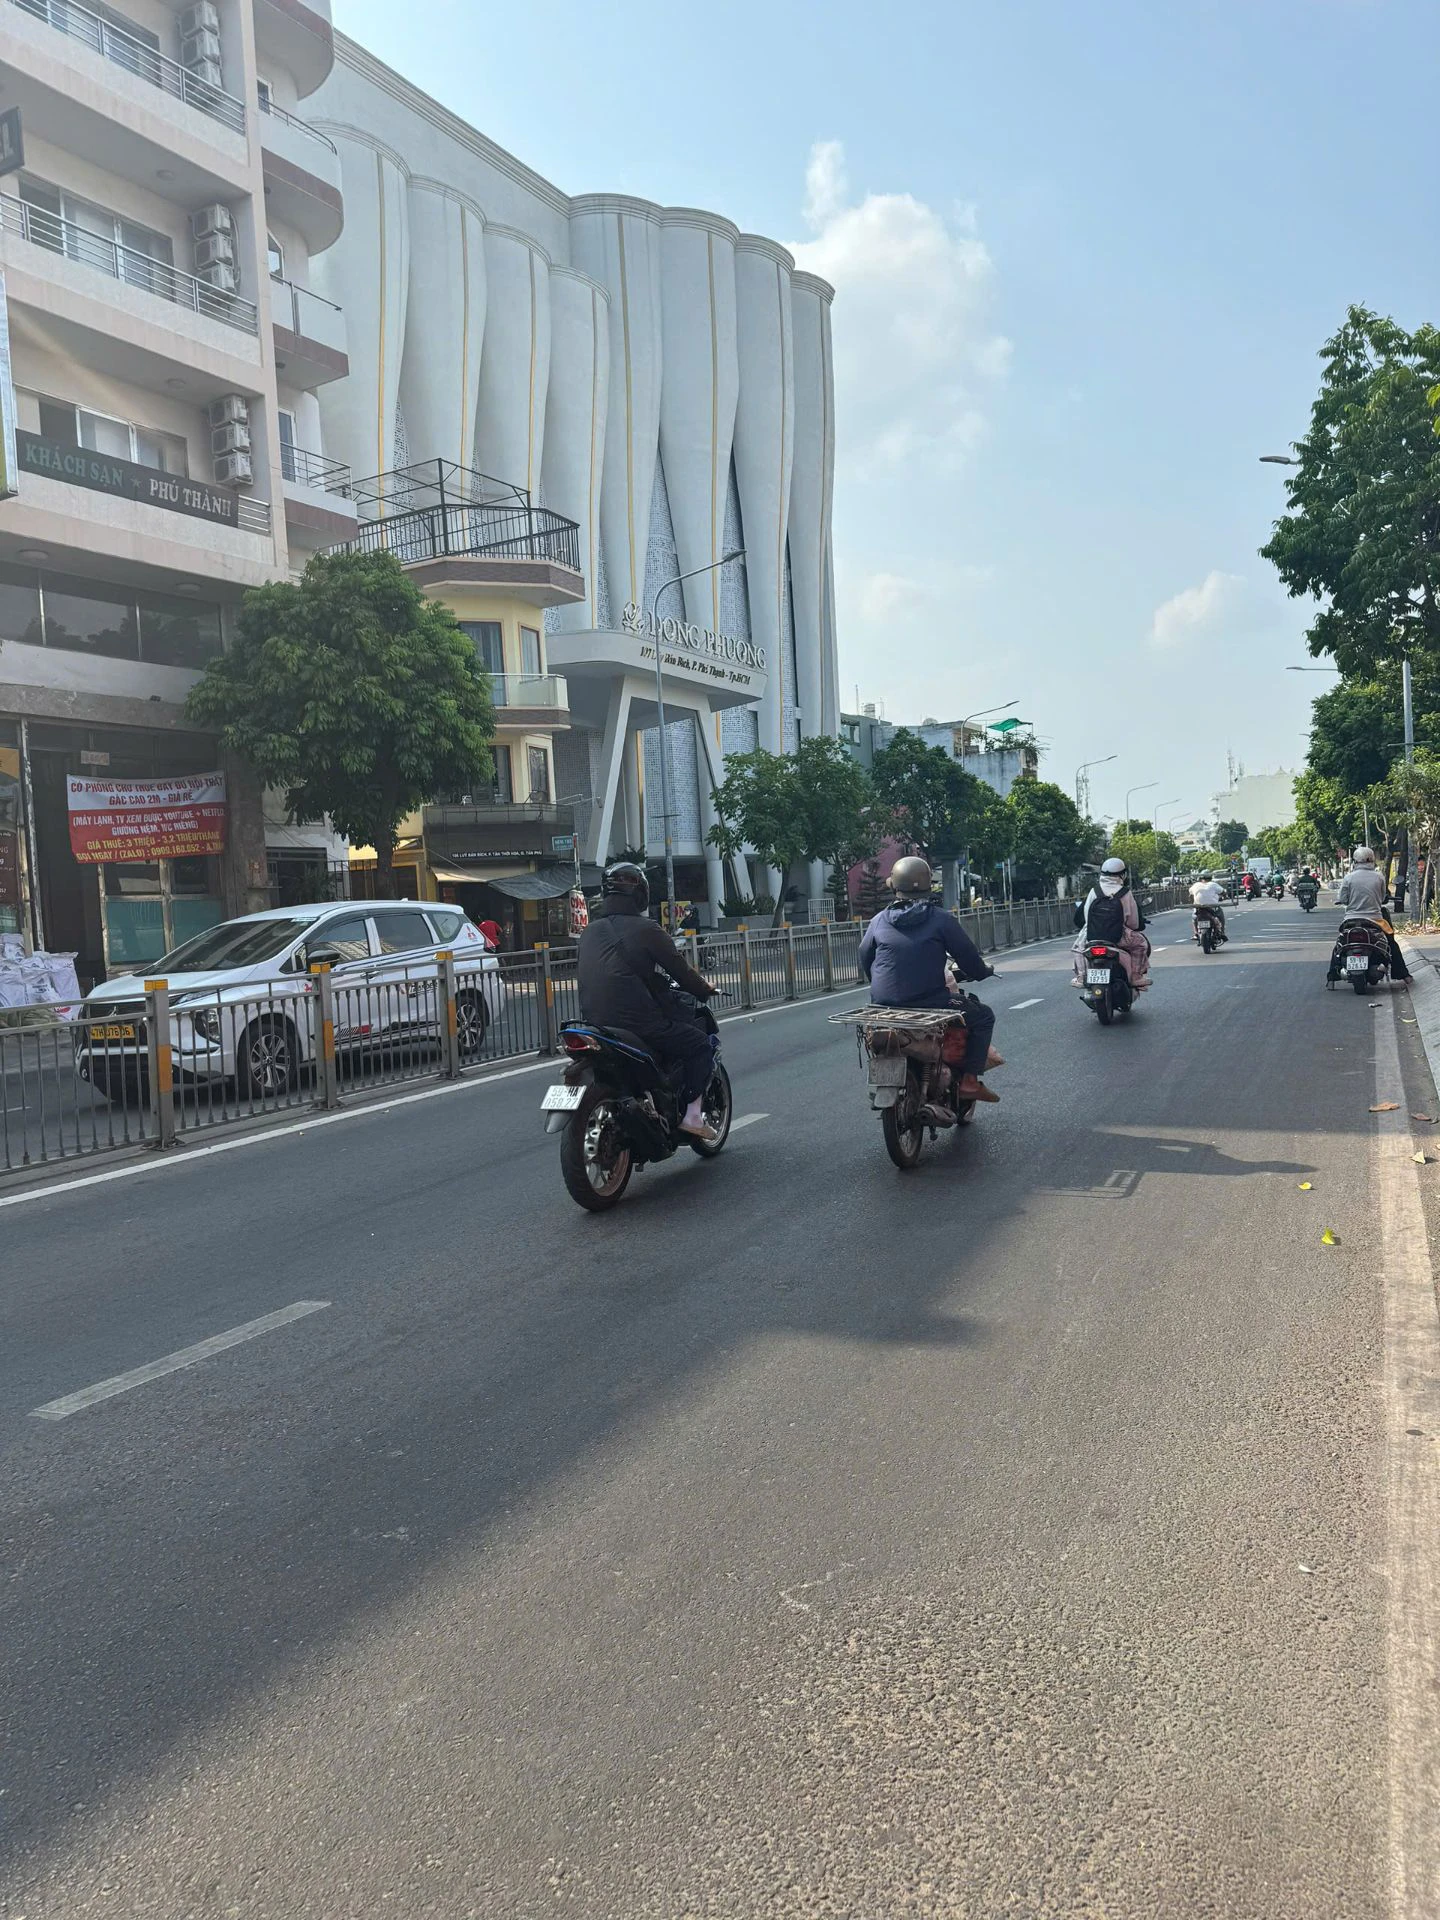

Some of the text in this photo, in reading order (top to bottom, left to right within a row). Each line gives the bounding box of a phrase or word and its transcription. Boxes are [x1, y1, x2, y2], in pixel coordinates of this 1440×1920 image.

[25, 443, 232, 516] KHÁCH SẠN PHÚ THÀNH
[130, 795, 146, 805] CAO
[147, 794, 161, 804] 2M
[168, 791, 180, 802] GIÁ
[116, 815, 124, 824] TV
[126, 814, 142, 823] XEM
[164, 810, 194, 821] YOUTUBE
[87, 839, 101, 850] GIÁ
[127, 839, 132, 847] 3
[91, 851, 113, 860] NGAY
[120, 848, 145, 860] (ZALO)
